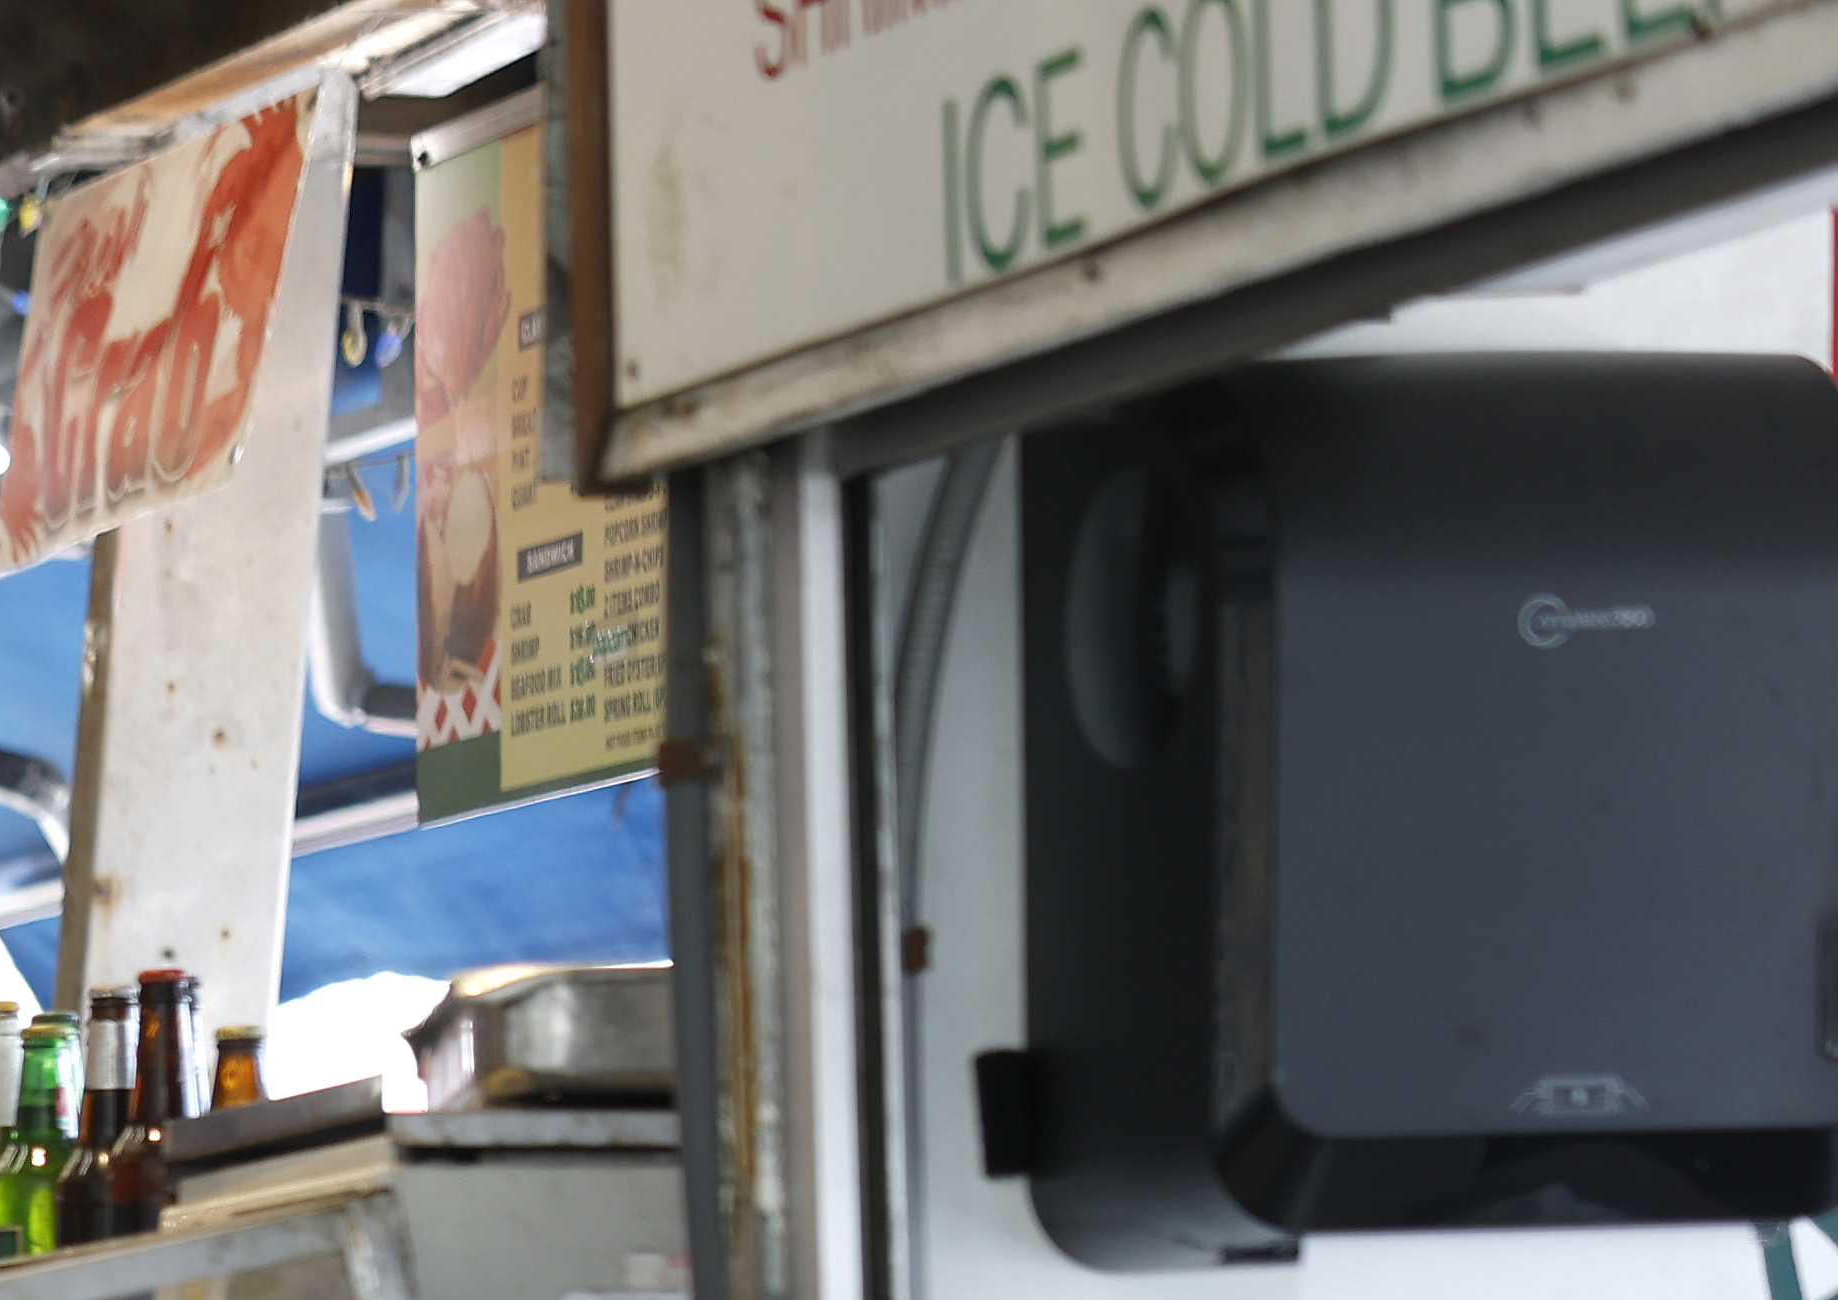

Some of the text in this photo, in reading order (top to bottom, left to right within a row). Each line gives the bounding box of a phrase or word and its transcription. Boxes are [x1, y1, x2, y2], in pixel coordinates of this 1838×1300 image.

[939, 49, 1090, 283] ICE
[1119, 0, 1394, 211] COLD
[526, 537, 575, 575] SANDWICH
[511, 601, 532, 631] CRAB
[511, 634, 540, 667] SHRIMP
[511, 699, 566, 738] LOBSTER ROLL
